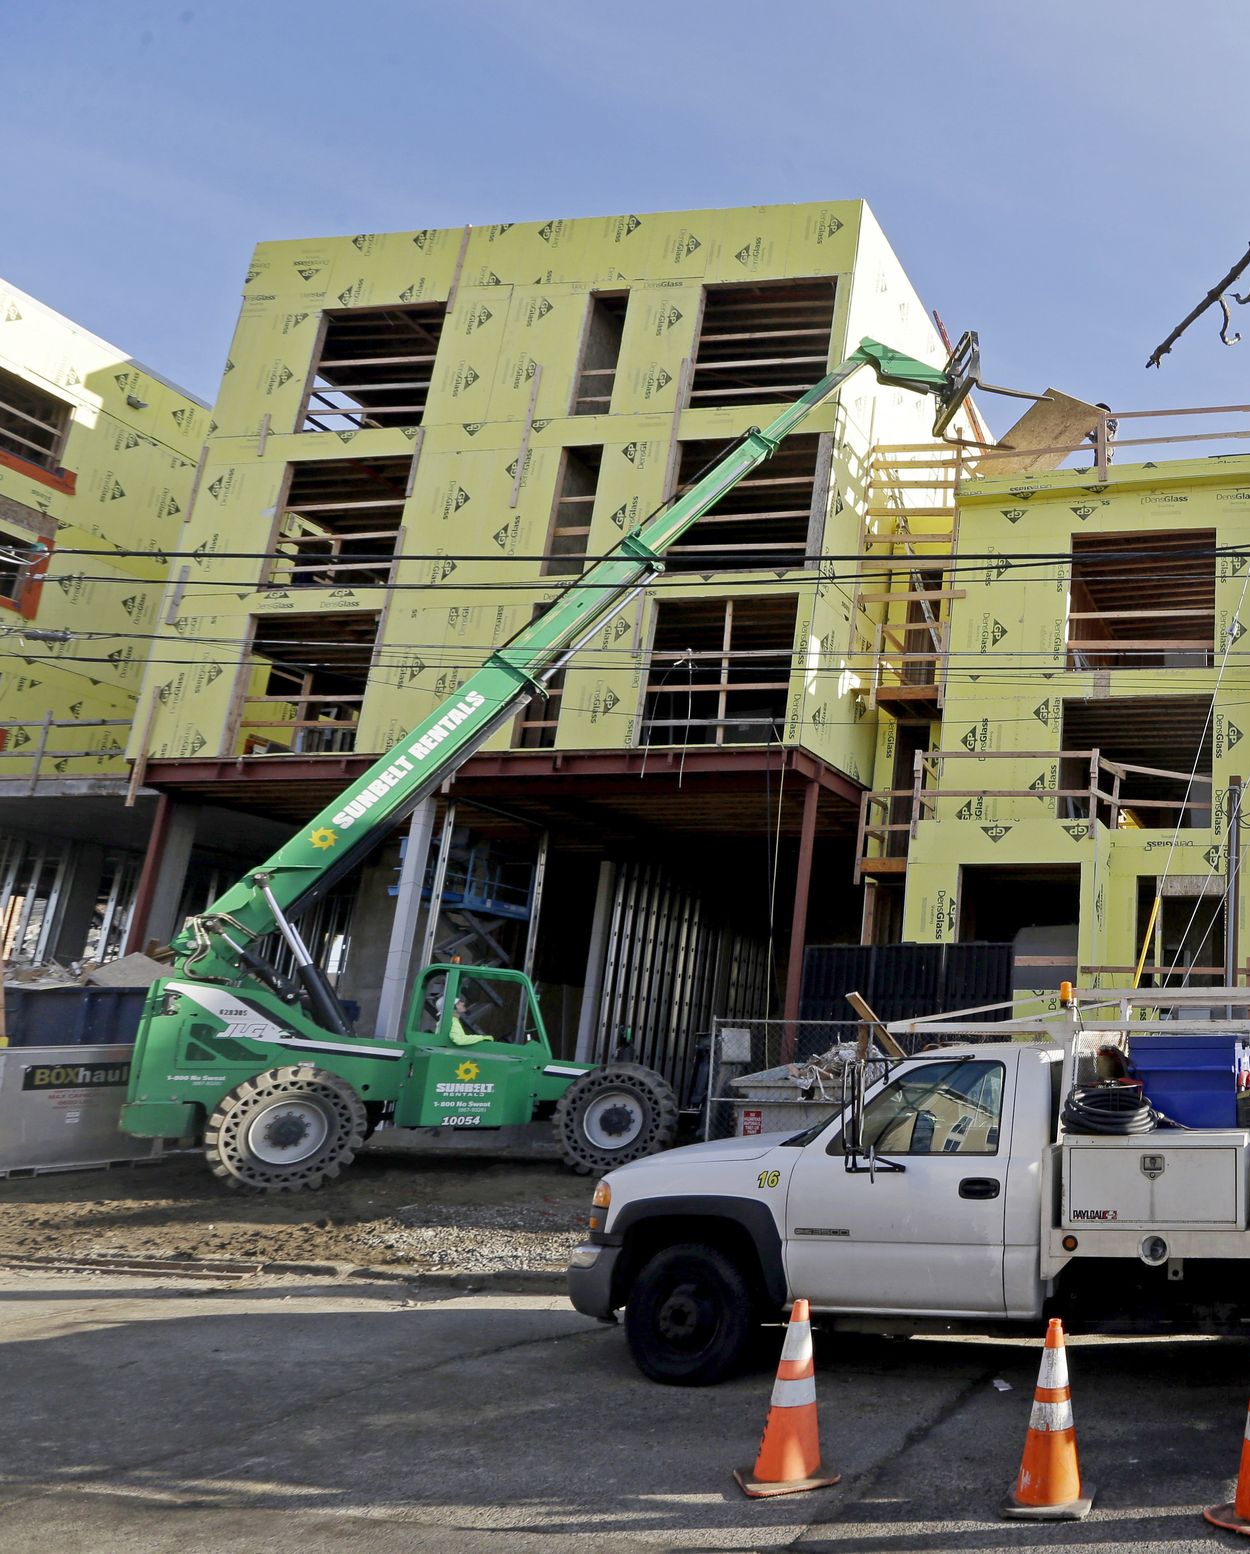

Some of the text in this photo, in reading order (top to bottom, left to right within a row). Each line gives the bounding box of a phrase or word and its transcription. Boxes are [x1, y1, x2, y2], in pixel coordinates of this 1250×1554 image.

[817, 210, 828, 244] DensGlass
[751, 236, 762, 272] DensGlass
[656, 299, 667, 336] DensGlass
[645, 362, 657, 400] DensGlass
[220, 468, 235, 506] DensGlass
[520, 448, 532, 488] DensGlass
[443, 480, 456, 520] DensGlass
[508, 516, 520, 556] DensGlass
[320, 600, 360, 608] DensGlass
[798, 620, 810, 664] DensGlass
[980, 612, 990, 654] DensGlass
[1220, 610, 1228, 653] DensGlass
[590, 680, 604, 724] DensGlass
[788, 694, 802, 740] DensGlass
[1216, 714, 1224, 759] DensGlass
[332, 690, 486, 830] SUNBELT RENTALS
[1214, 789, 1224, 836] DensGlass
[936, 890, 946, 940] DensGlass
[216, 1024, 268, 1038] JLG
[436, 1083, 494, 1092] SUNBELT
[441, 1116, 480, 1126] 10054
[757, 1170, 780, 1188] 16
